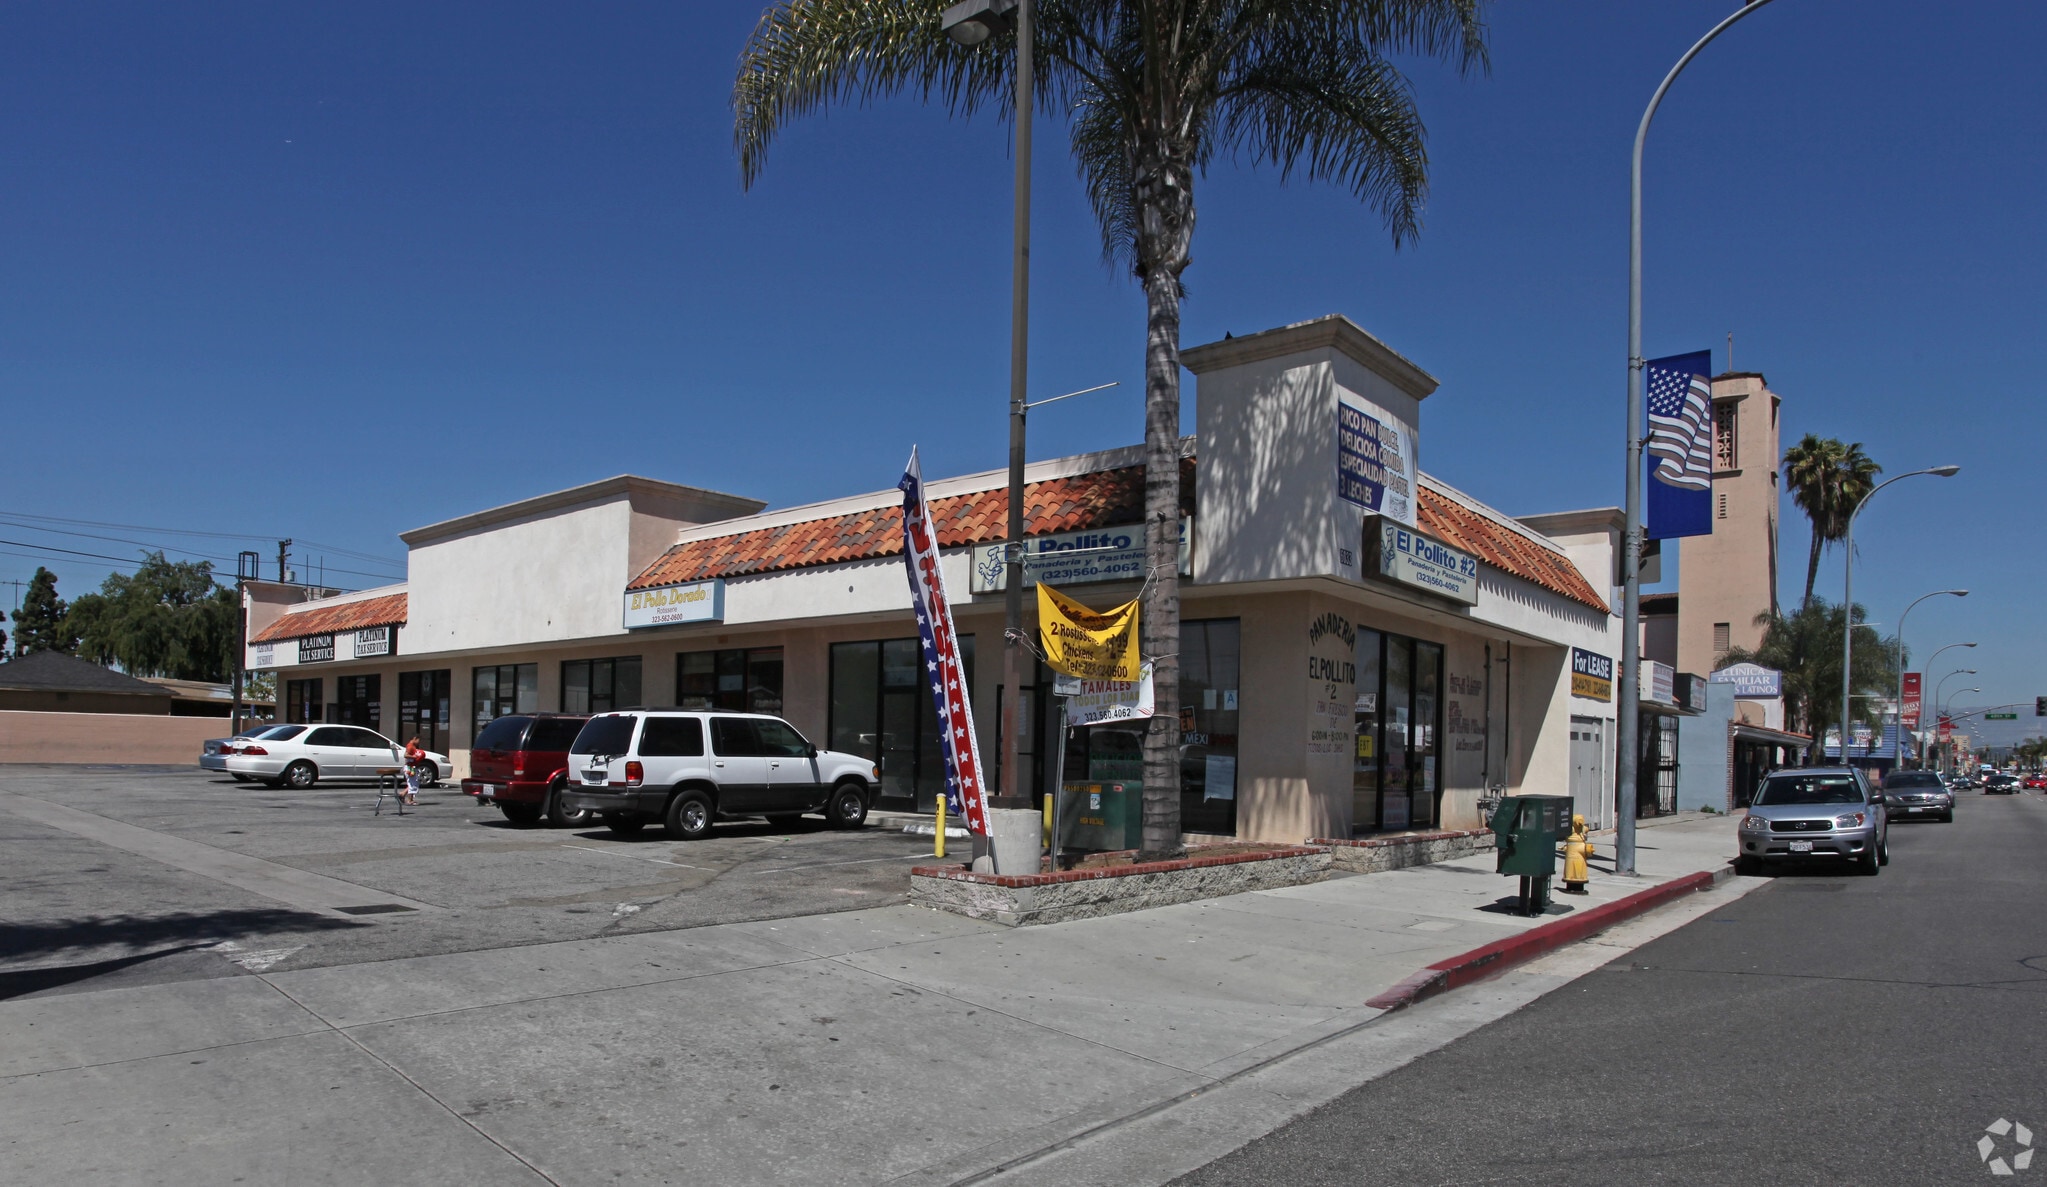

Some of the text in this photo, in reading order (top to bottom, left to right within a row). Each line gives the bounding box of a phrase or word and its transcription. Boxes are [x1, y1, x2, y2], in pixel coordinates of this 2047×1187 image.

[1341, 407, 1359, 430] RICO
[1361, 417, 1376, 439] PAN
[1341, 428, 1404, 475] DELICIOSA COMIDA
[1341, 452, 1409, 498] ESPECIALIDAD PASTEL
[1341, 474, 1372, 504] 3 LECHES
[1039, 533, 1131, 558] Pollito
[1397, 530, 1476, 577] El Pollito #2
[1042, 562, 1139, 581] (323)560-4062
[1407, 558, 1435, 573] Panaderia
[1416, 572, 1459, 593] (323)560-4062
[631, 593, 642, 610] El
[643, 590, 667, 608] Pollo
[669, 584, 706, 604] Dorado
[359, 629, 385, 643] PLATINUM
[1050, 622, 1058, 635] 2
[1310, 612, 1355, 653] PANADERIA
[301, 636, 332, 648] PLATINUM
[357, 642, 387, 654] TAX SERVICE
[1062, 642, 1095, 660] Chickens
[300, 648, 334, 661] TAX SERVICE
[1309, 656, 1355, 685] EL POLLITO
[1574, 651, 1609, 678] For LEASE
[1722, 667, 1765, 676] CLINICA
[1082, 680, 1131, 695] TAMALES
[1742, 686, 1778, 694] LATINOS
[1074, 694, 1100, 708] TODOS
[1103, 692, 1118, 704] LOS
[1227, 693, 1235, 704] A
[1085, 708, 1131, 722] 323.560.4062
